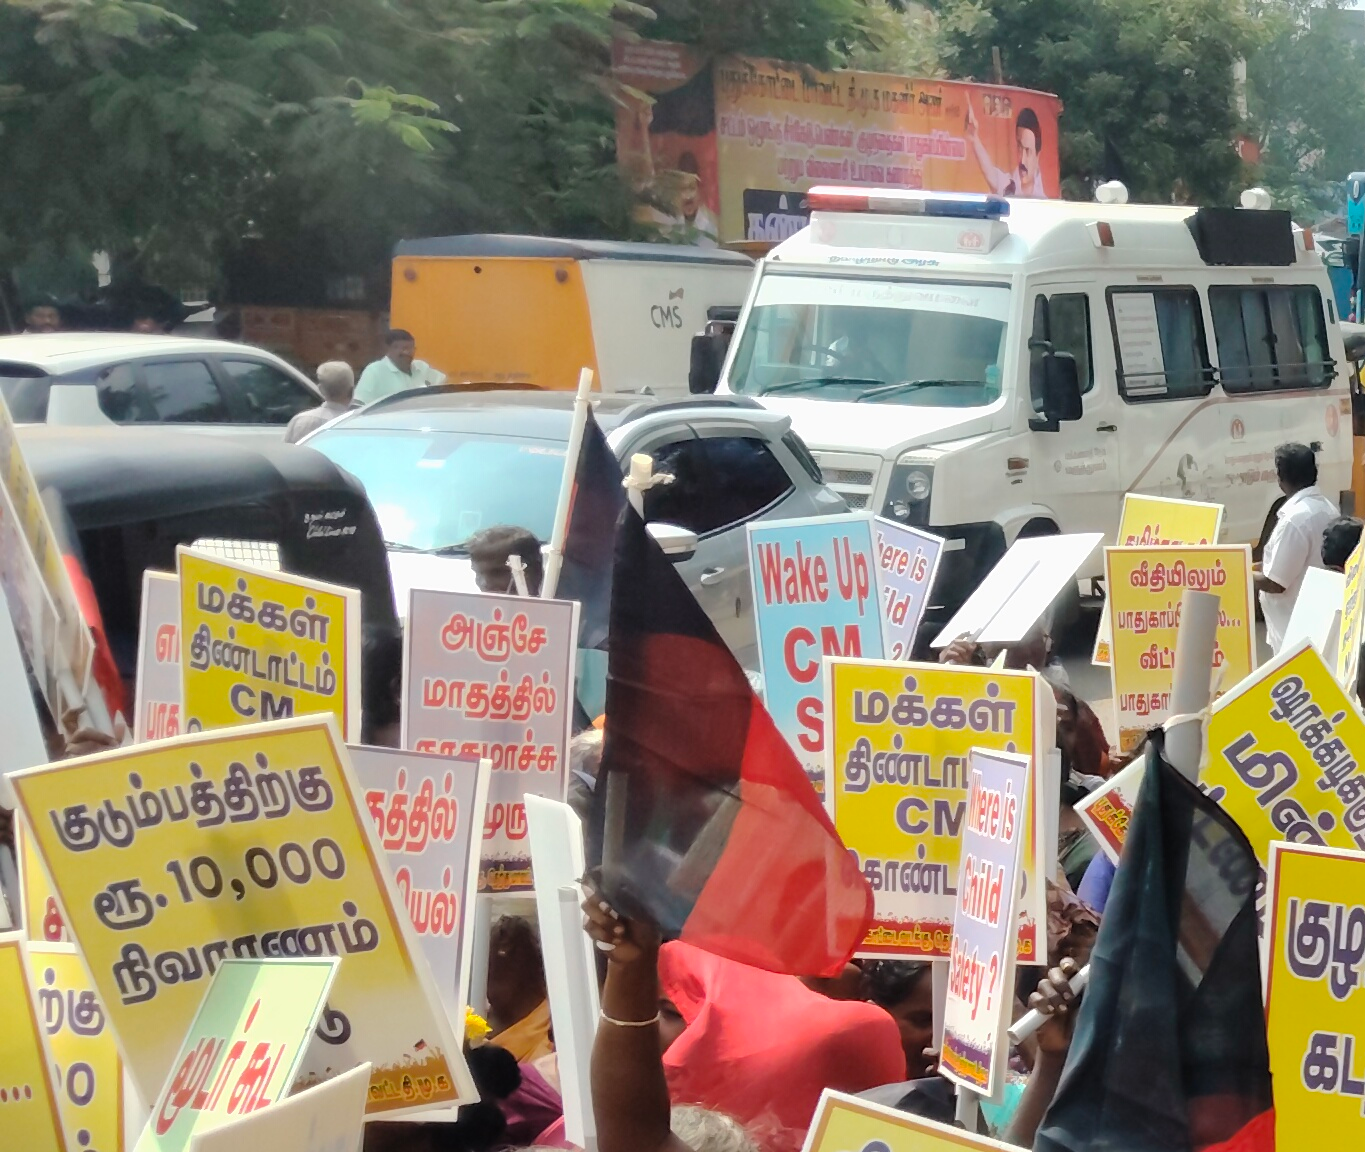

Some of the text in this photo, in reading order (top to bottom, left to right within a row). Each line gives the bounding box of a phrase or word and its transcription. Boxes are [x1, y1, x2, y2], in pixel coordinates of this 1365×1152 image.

[650, 304, 682, 328] CMS
[756, 537, 870, 616] Wake Up
[911, 547, 928, 582] is
[1130, 558, 1227, 593] வீதியிலும்
[196, 577, 330, 643] மக்கள்
[441, 608, 549, 664] அஞ்சே
[189, 625, 337, 697] திண்டாட்டம்
[783, 624, 862, 683] CM
[230, 684, 294, 721] CM
[422, 670, 558, 721] மாதத்தில்
[853, 676, 1016, 735] மக்கள்
[48, 752, 335, 852] குடும்பத்திற்கு
[970, 769, 1017, 842] Where is
[961, 854, 1005, 928] Child
[950, 936, 986, 1021] Safety
